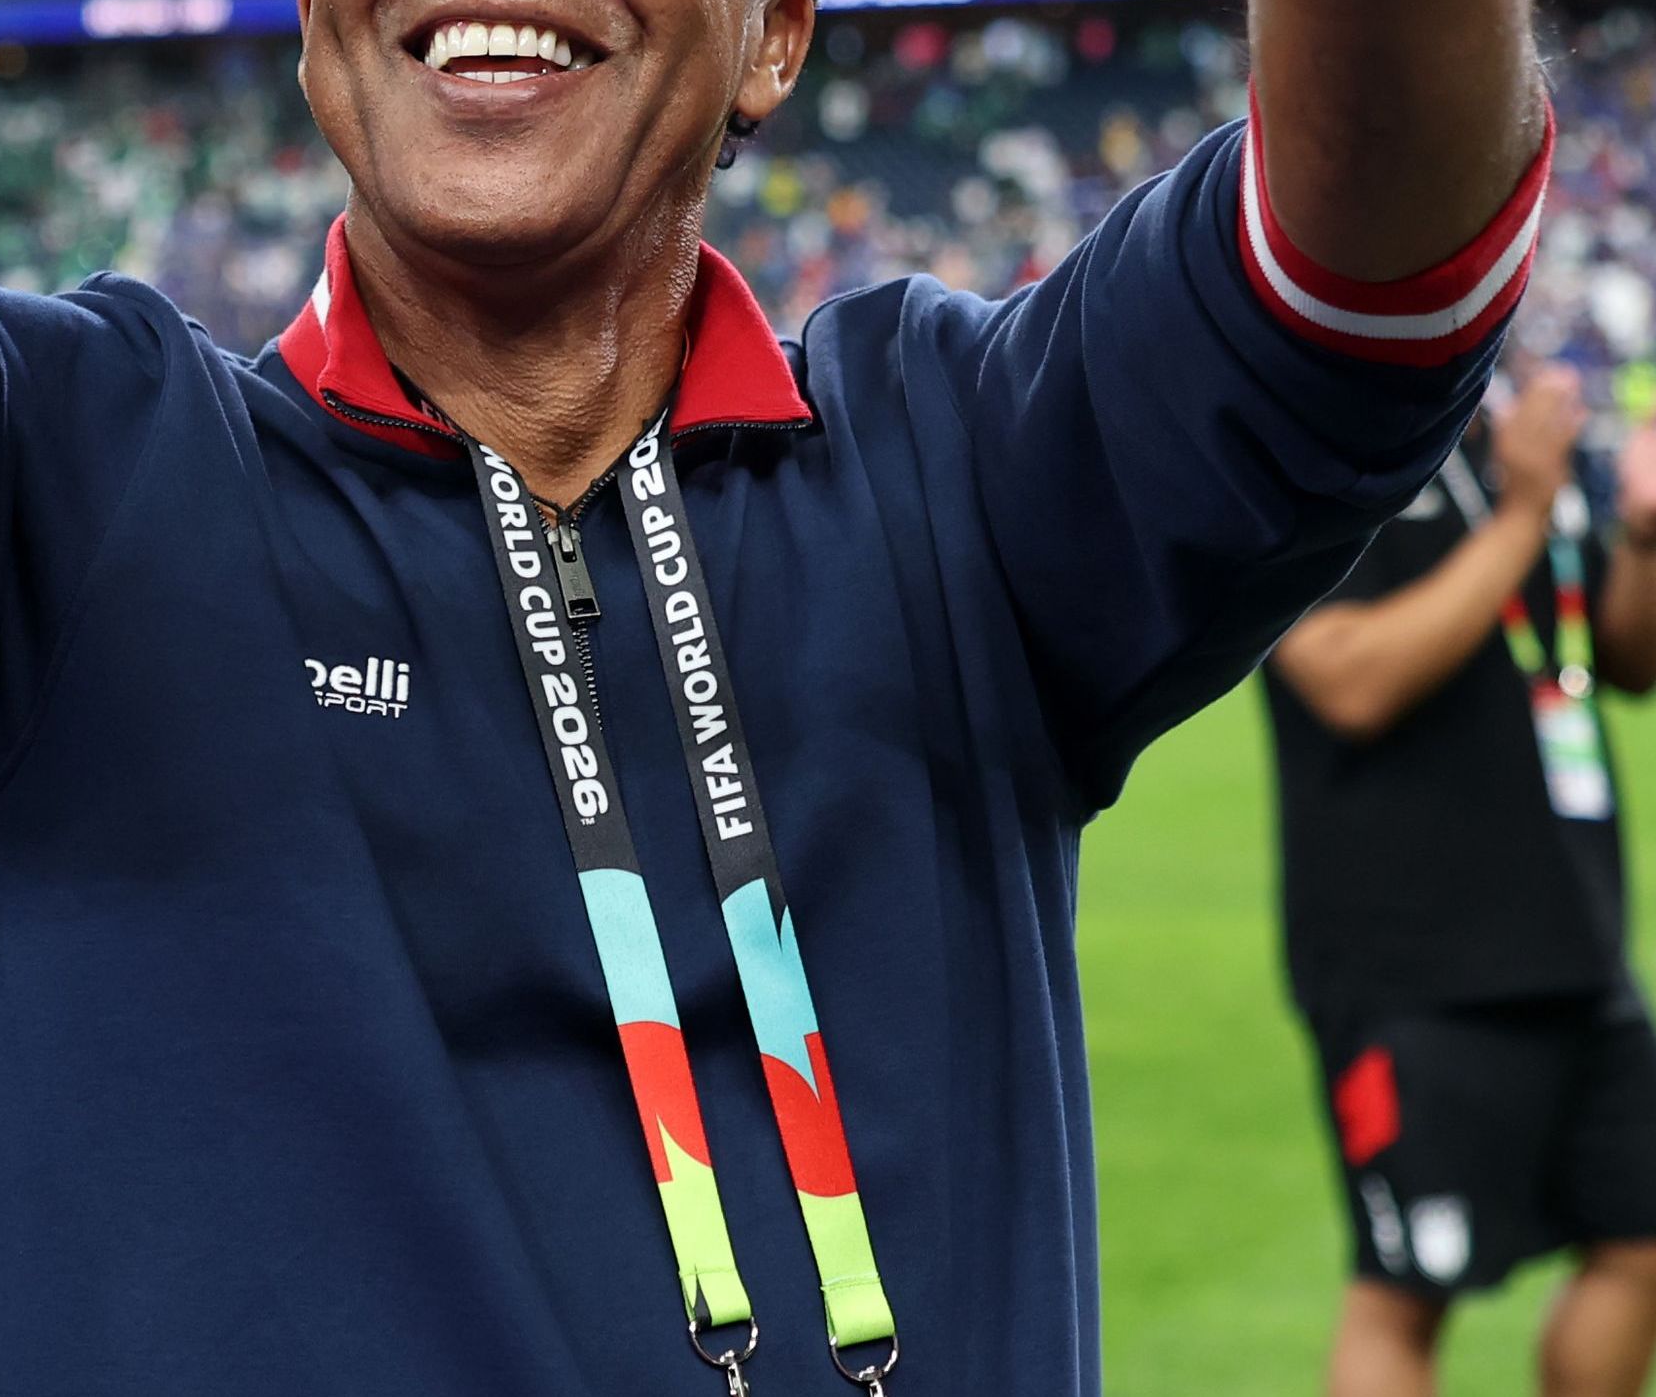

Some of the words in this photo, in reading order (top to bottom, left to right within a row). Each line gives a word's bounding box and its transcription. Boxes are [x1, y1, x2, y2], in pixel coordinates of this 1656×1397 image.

[478, 444, 542, 579] WORLD
[642, 505, 689, 586] CUP
[519, 585, 567, 666] CUP
[665, 590, 729, 745] WORLD
[541, 672, 609, 818] 2026
[701, 742, 754, 841] FIFA
